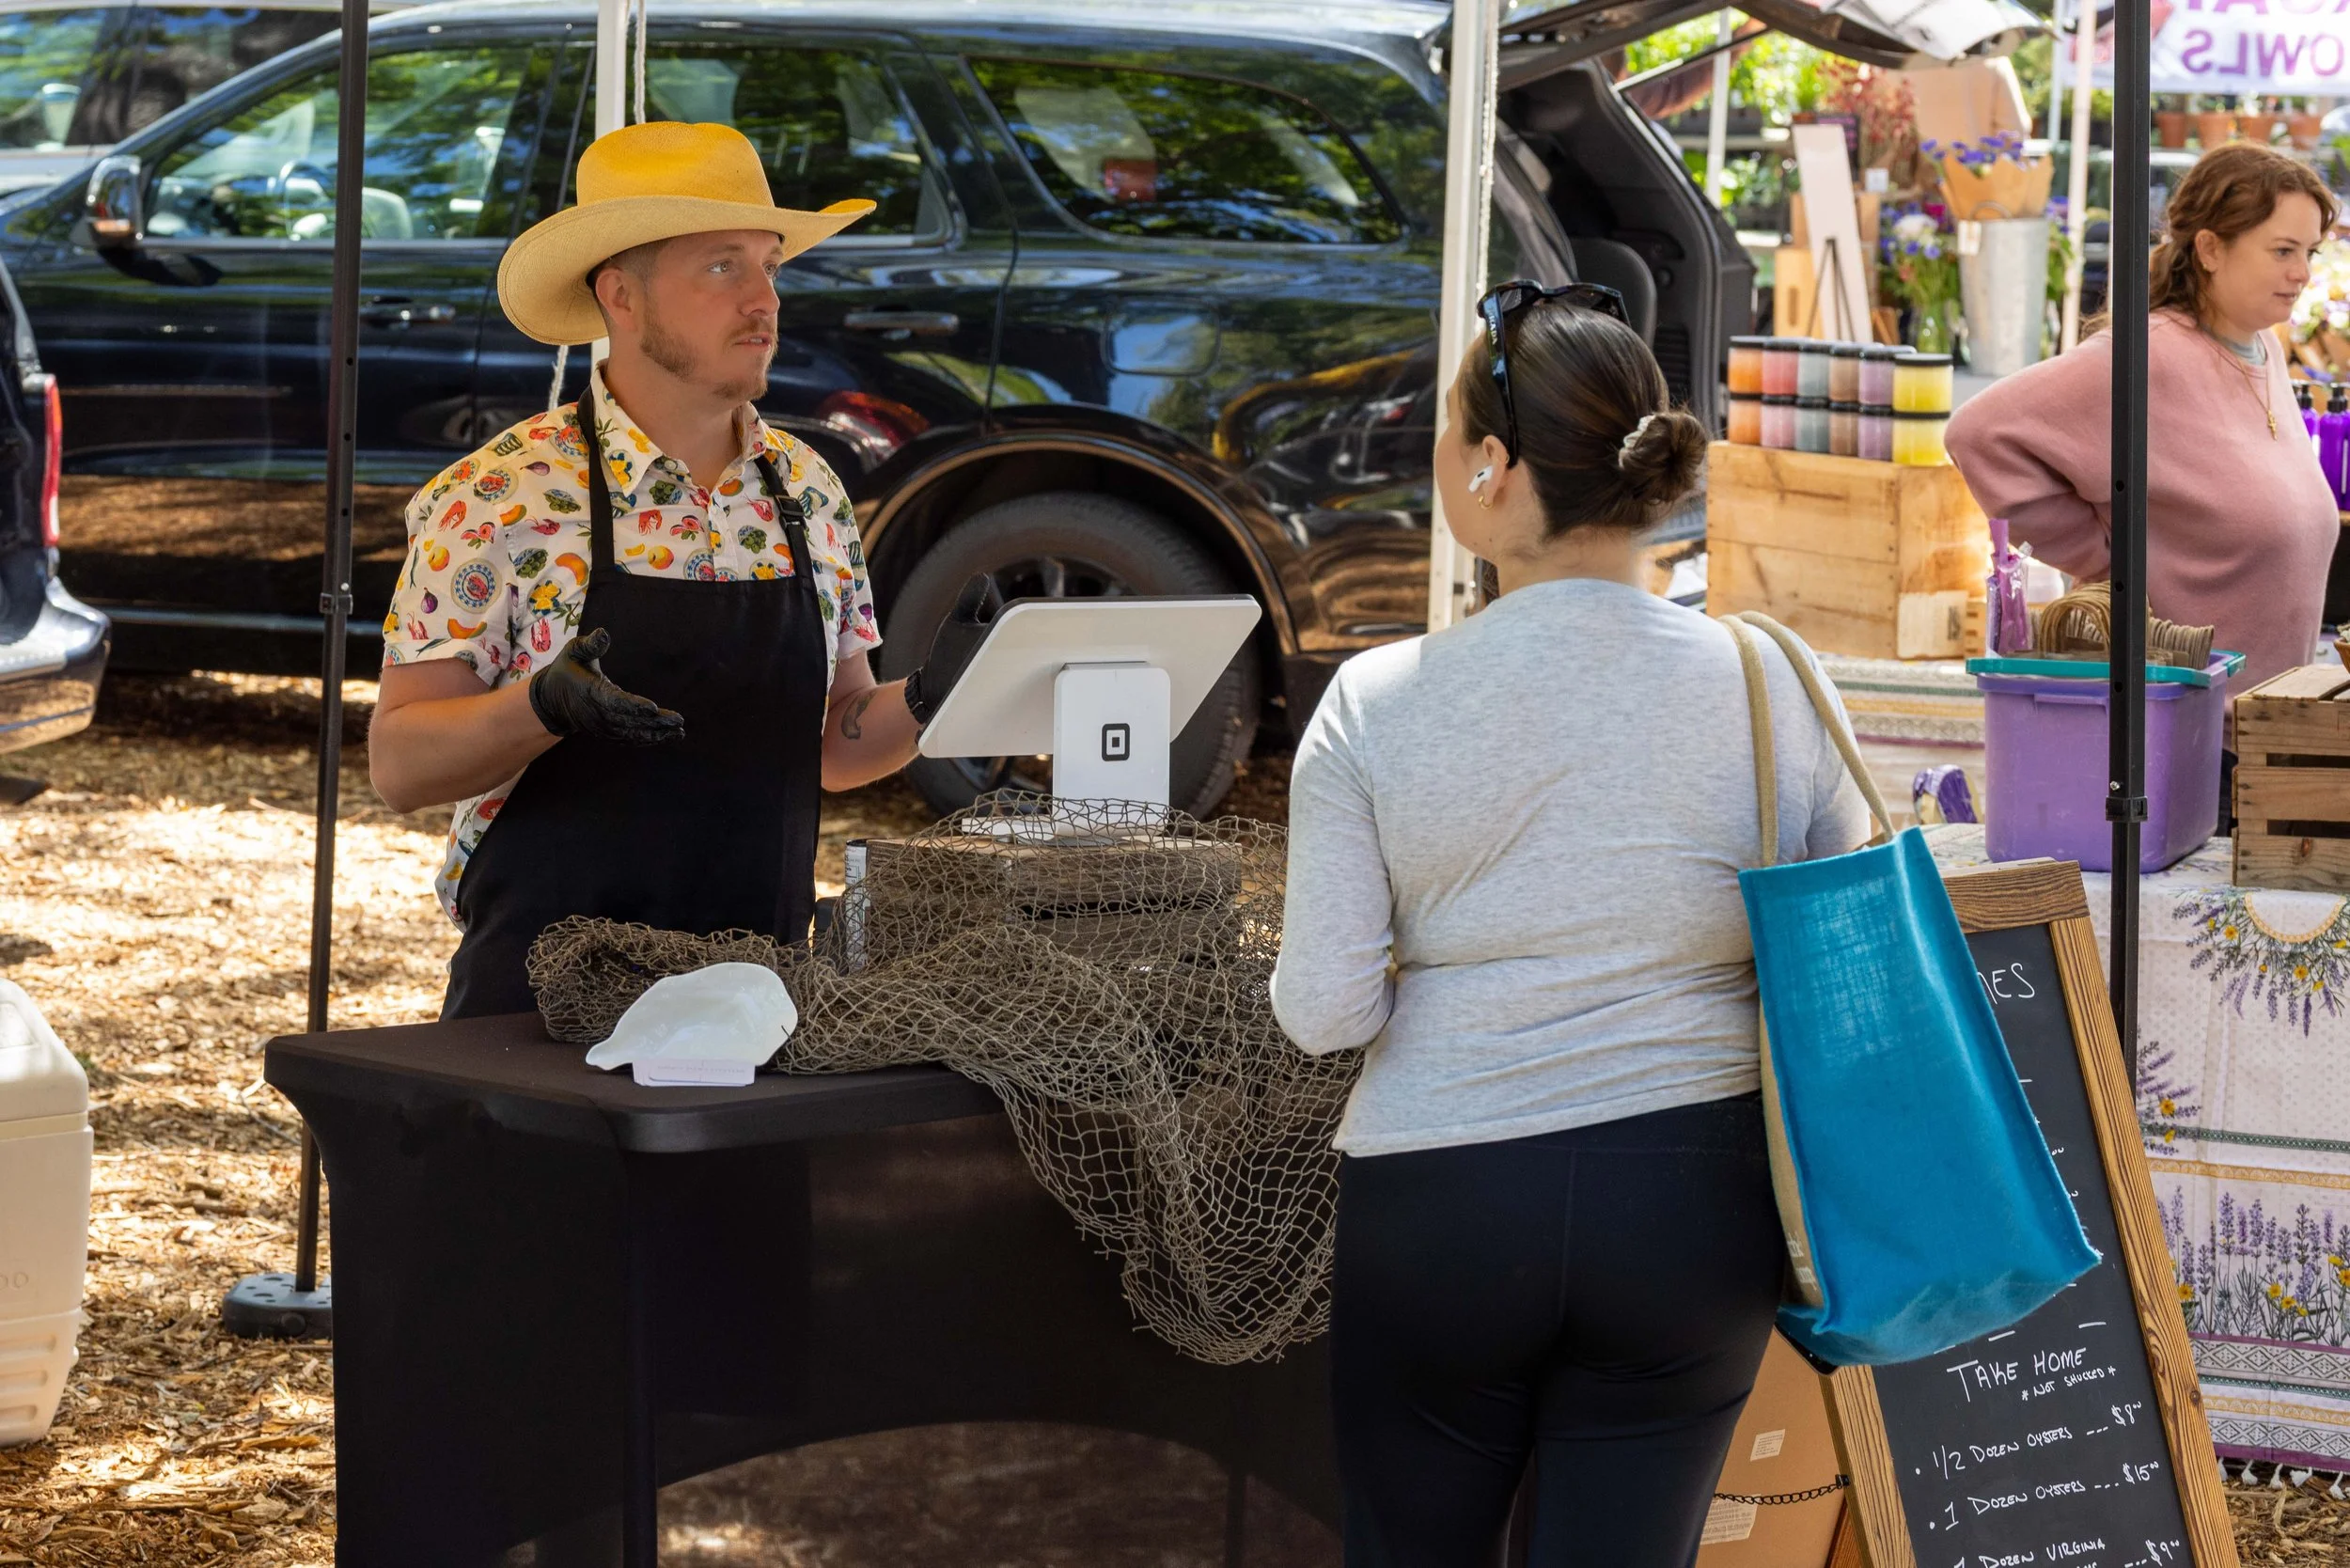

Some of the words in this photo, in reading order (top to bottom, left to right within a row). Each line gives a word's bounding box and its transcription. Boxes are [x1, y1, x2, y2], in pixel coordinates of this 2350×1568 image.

[1947, 1359, 2018, 1403] TAKE
[2033, 1347, 2087, 1375] HOME
[1933, 1445, 1966, 1480] 1/2
[1969, 1441, 2019, 1463] DOZEN
[2028, 1427, 2073, 1447] OYSTERS
[1945, 1501, 1959, 1530] 1
[1967, 1493, 2028, 1514] DOZEN
[2035, 1481, 2086, 1499] OYSTERS
[1979, 1551, 2034, 1568] DOZEN
[2046, 1538, 2106, 1561] VIRGINIA
